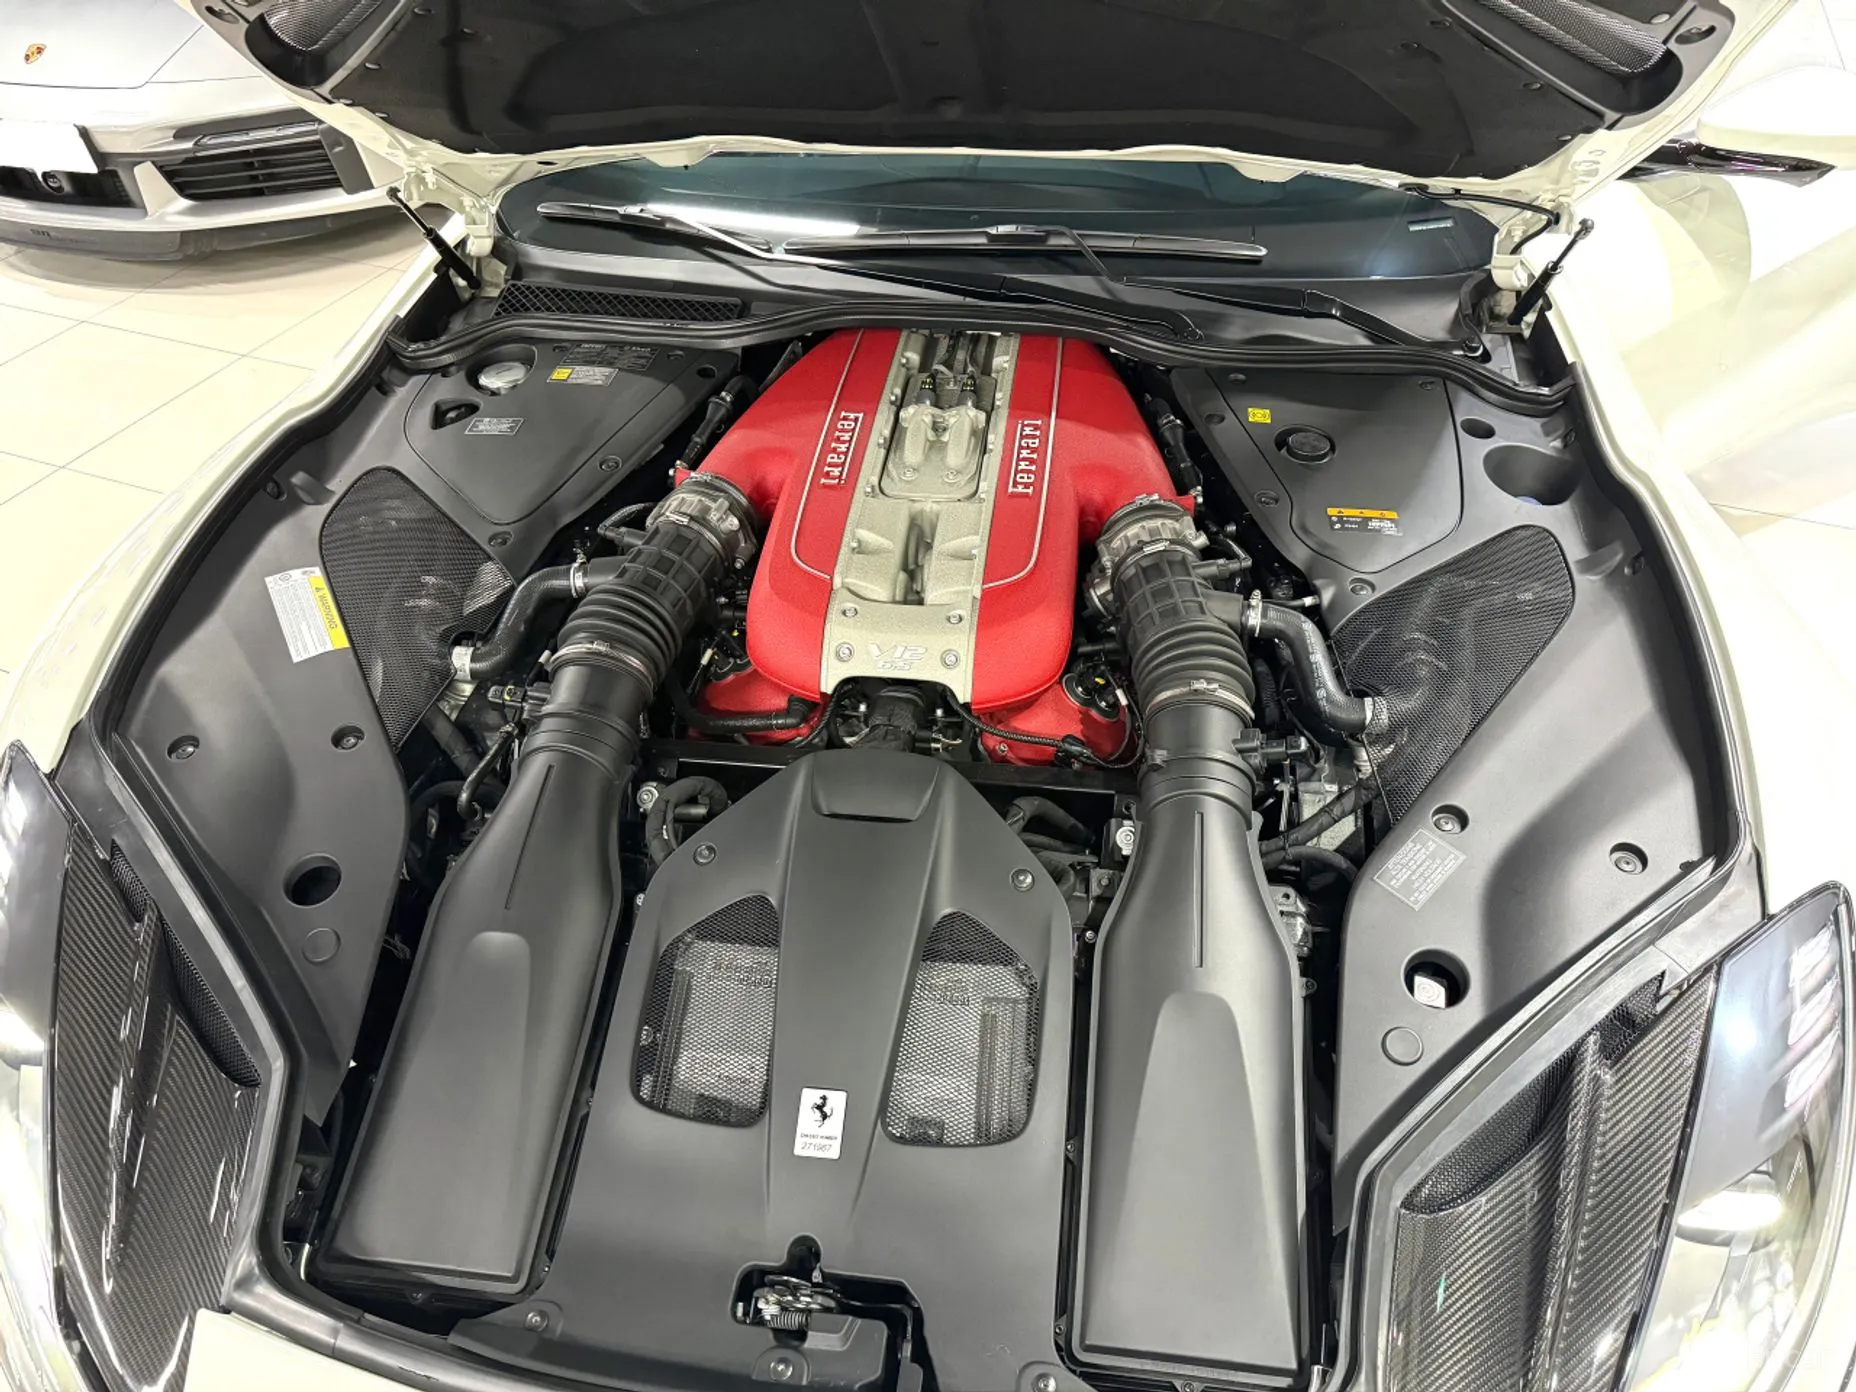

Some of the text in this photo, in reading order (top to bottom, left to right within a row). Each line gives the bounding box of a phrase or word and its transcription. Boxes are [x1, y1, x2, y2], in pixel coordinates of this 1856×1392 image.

[819, 410, 864, 485] Ferrari
[1008, 420, 1042, 496] Ferrari
[867, 642, 928, 661] V12
